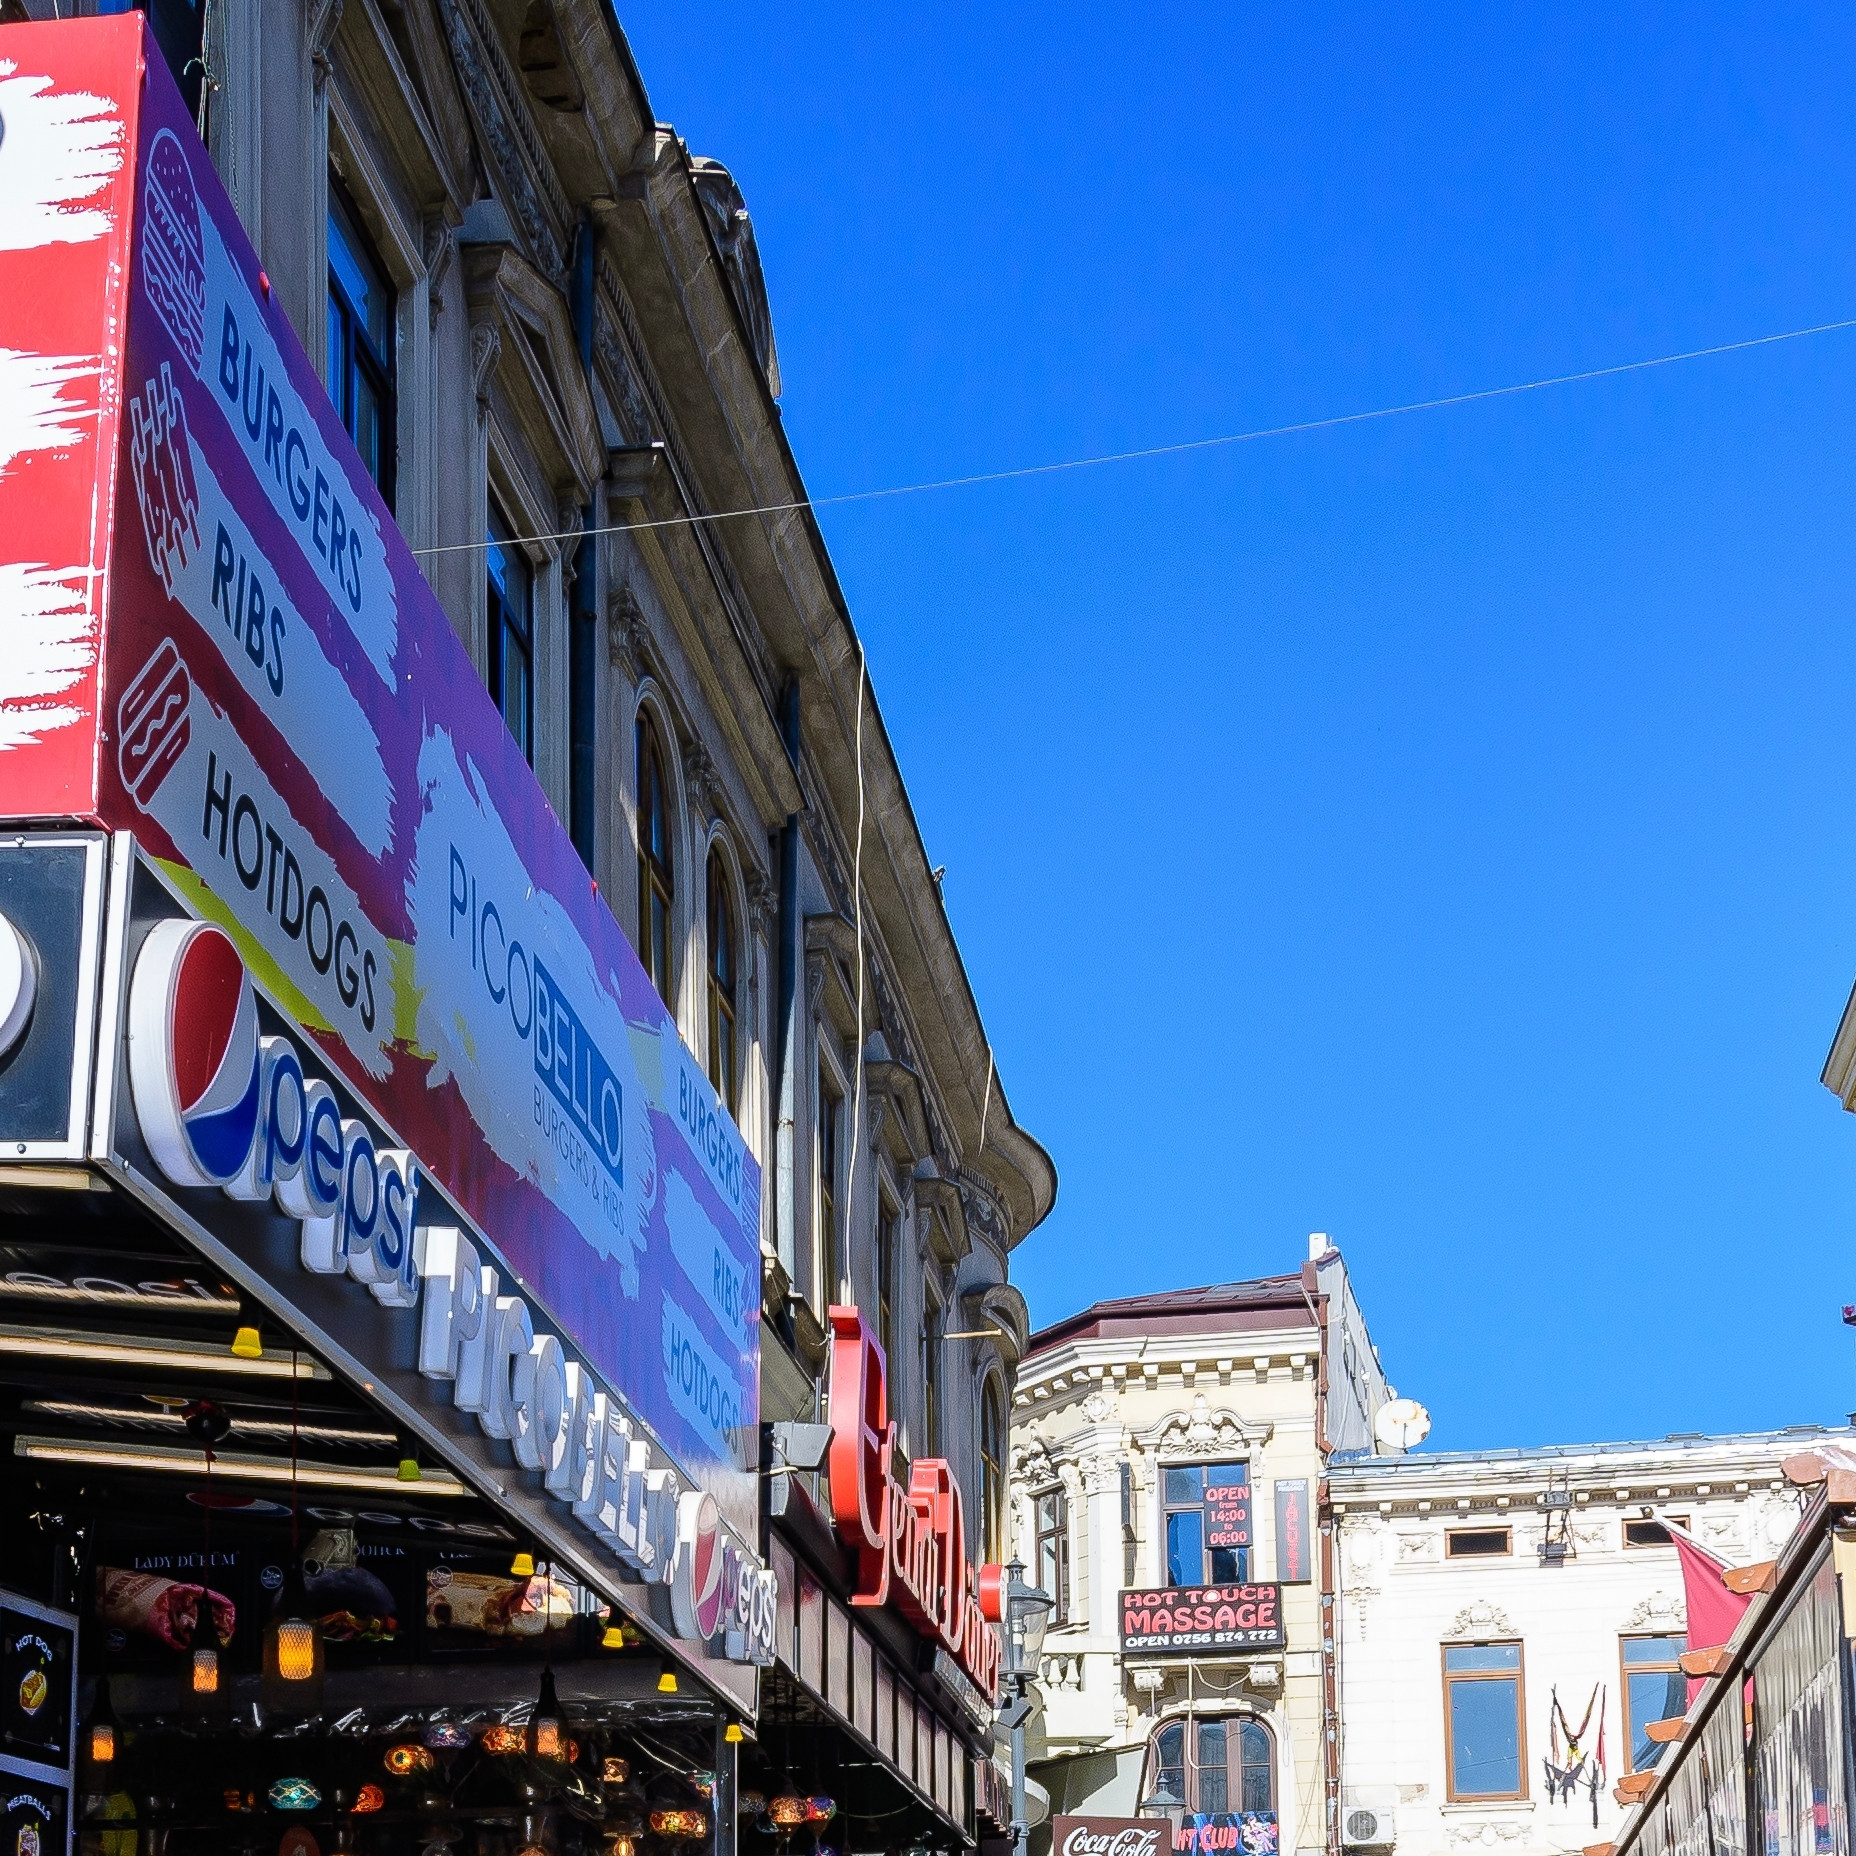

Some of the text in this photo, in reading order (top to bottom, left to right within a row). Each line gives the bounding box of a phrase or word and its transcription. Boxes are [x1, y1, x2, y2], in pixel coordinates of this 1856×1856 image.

[218, 304, 364, 614] BURGERS
[211, 530, 287, 698] RIBS
[203, 750, 376, 1034] HOTDOGS
[450, 842, 624, 1172] PICOBELLO
[259, 1045, 424, 1293] pepsi
[534, 1083, 589, 1187] BURGERS
[602, 1177, 625, 1236] RIBS
[680, 1065, 741, 1205] BURGERS
[713, 1247, 740, 1329] RIBS
[671, 1325, 739, 1454] HOTDOGS
[1206, 1486, 1249, 1501] OPEN
[1209, 1531, 1247, 1545] 06:00
[1210, 1510, 1246, 1523] 14:00
[1124, 1586, 1276, 1607] HOT TOUCH
[1125, 1602, 1276, 1634] MASSAGE
[1125, 1630, 1277, 1647] OPEN 0756 874 772
[1199, 1823, 1238, 1852] CLUB
